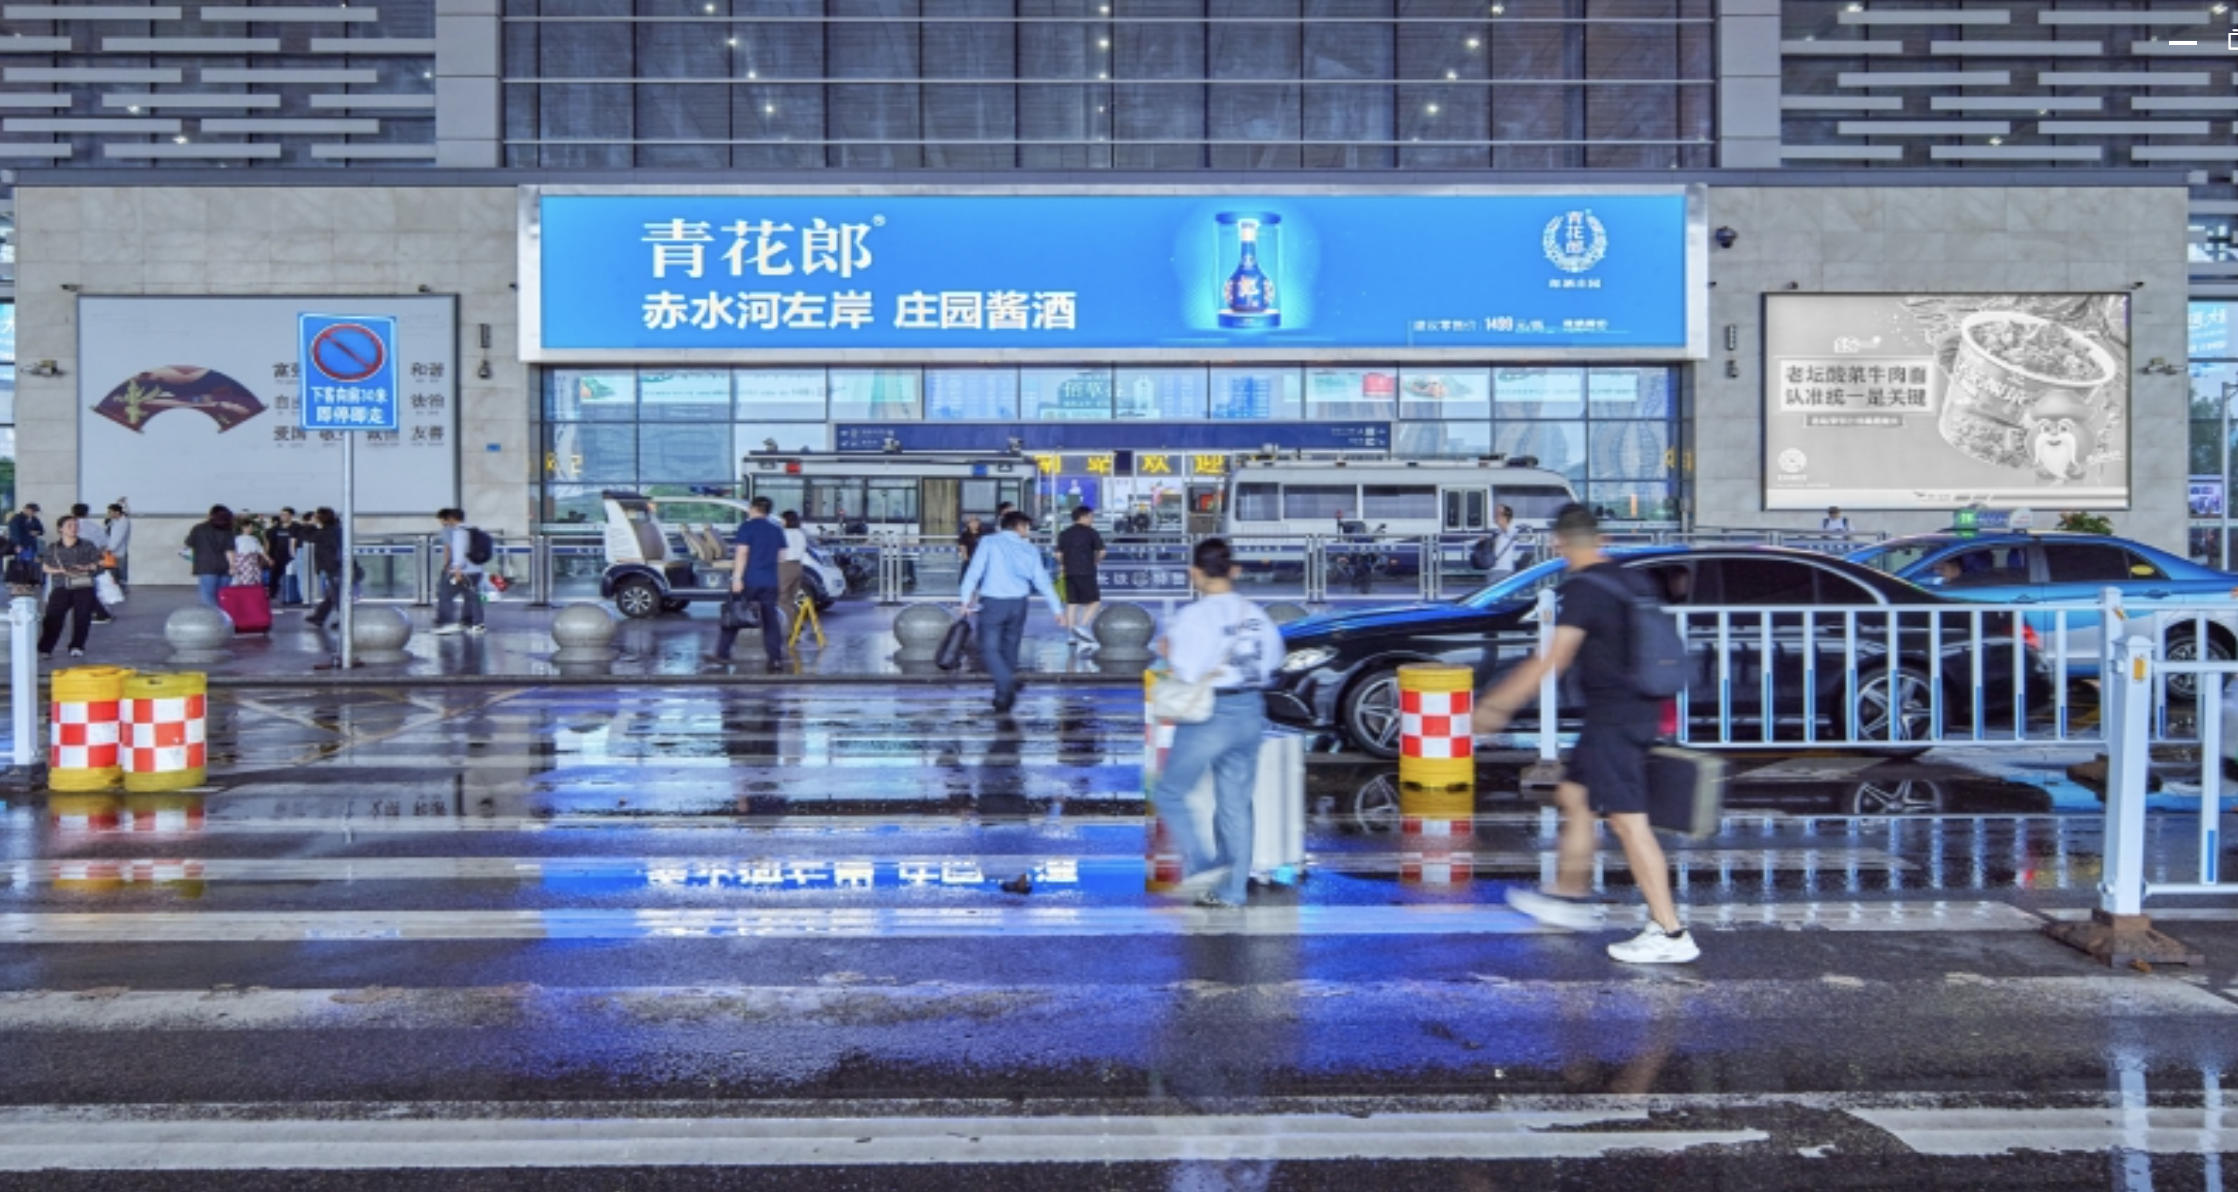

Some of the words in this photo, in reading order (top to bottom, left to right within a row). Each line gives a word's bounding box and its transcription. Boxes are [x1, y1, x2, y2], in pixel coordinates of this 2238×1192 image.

[641, 217, 873, 278] 青花郎
[642, 291, 874, 330] 赤水河左岸
[894, 291, 1077, 330] 庄园酱酒
[411, 362, 444, 378] 和谐
[1785, 365, 1926, 385] 老坛酸菜牛肉面
[410, 394, 444, 409] 法治
[1785, 388, 1927, 407] 认准统一是关键
[316, 405, 385, 424] 即停即走
[410, 425, 444, 441] 友善
